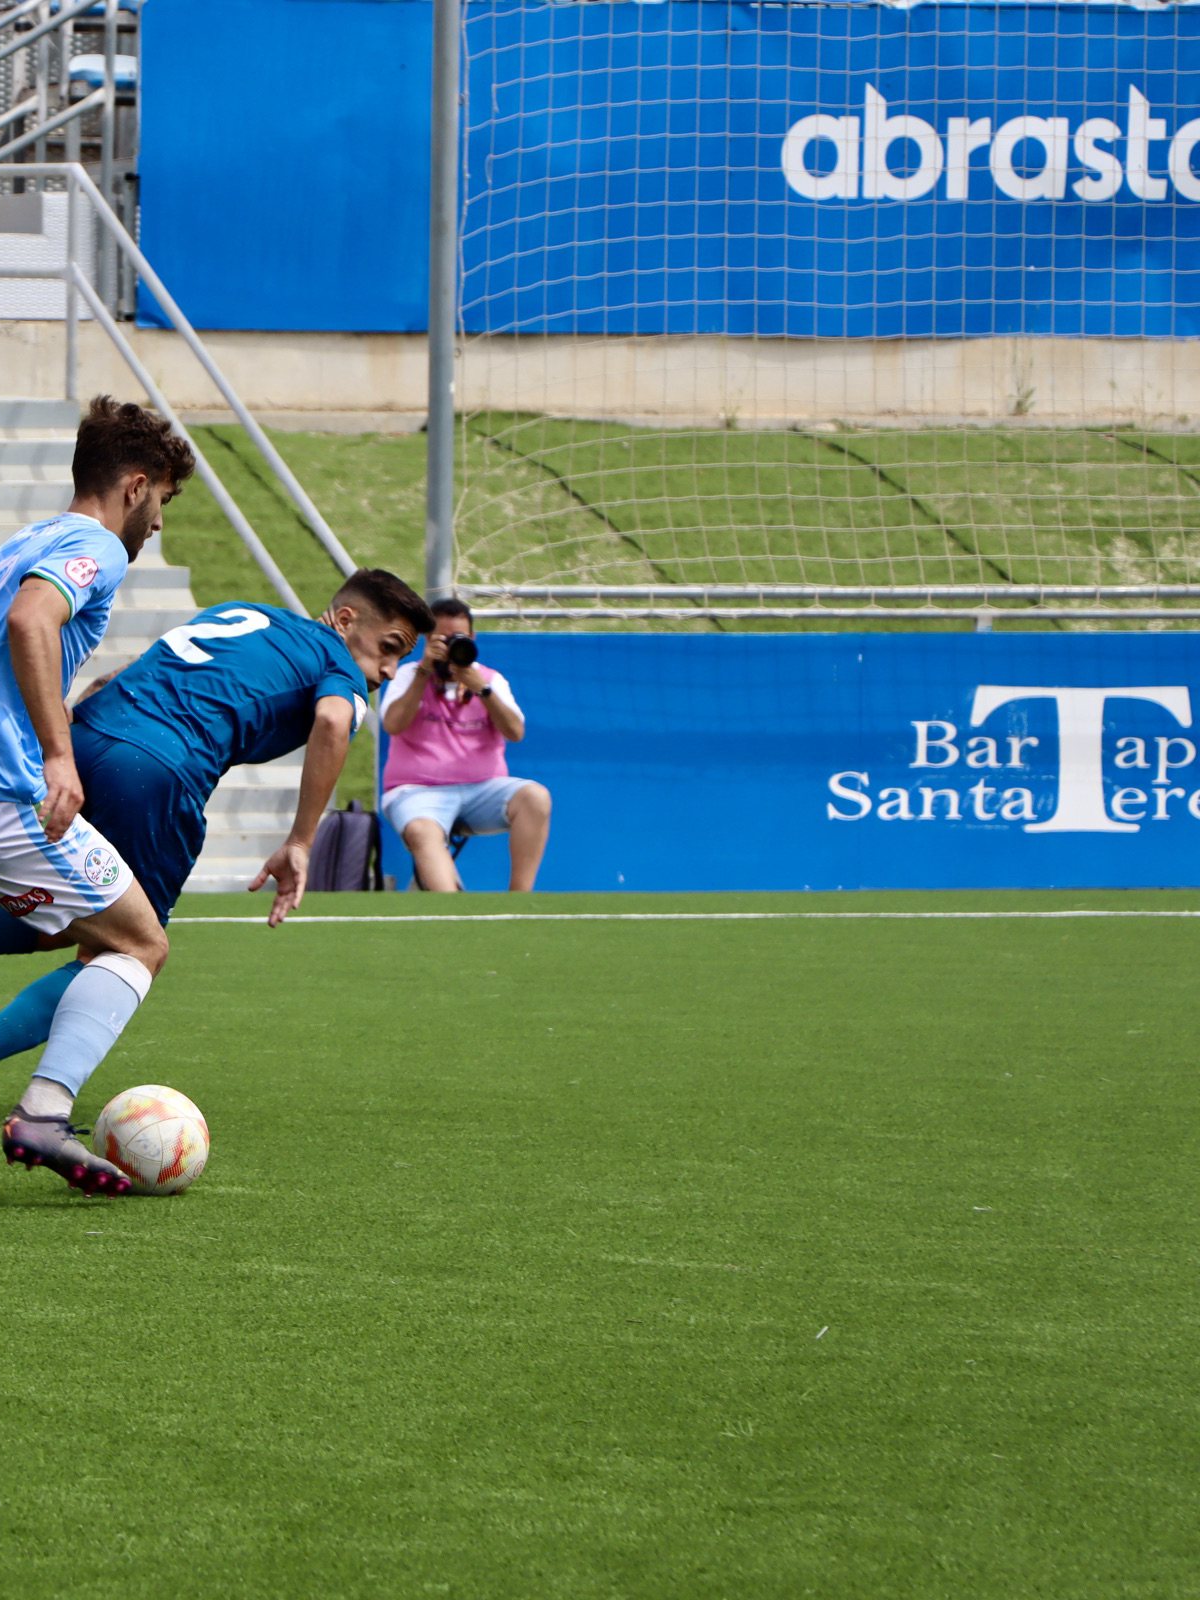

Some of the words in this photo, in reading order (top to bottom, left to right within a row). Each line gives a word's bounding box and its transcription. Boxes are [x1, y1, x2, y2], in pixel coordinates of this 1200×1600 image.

[160, 608, 271, 664] 2
[909, 720, 1040, 769] Bar
[826, 770, 1039, 821] Santa
